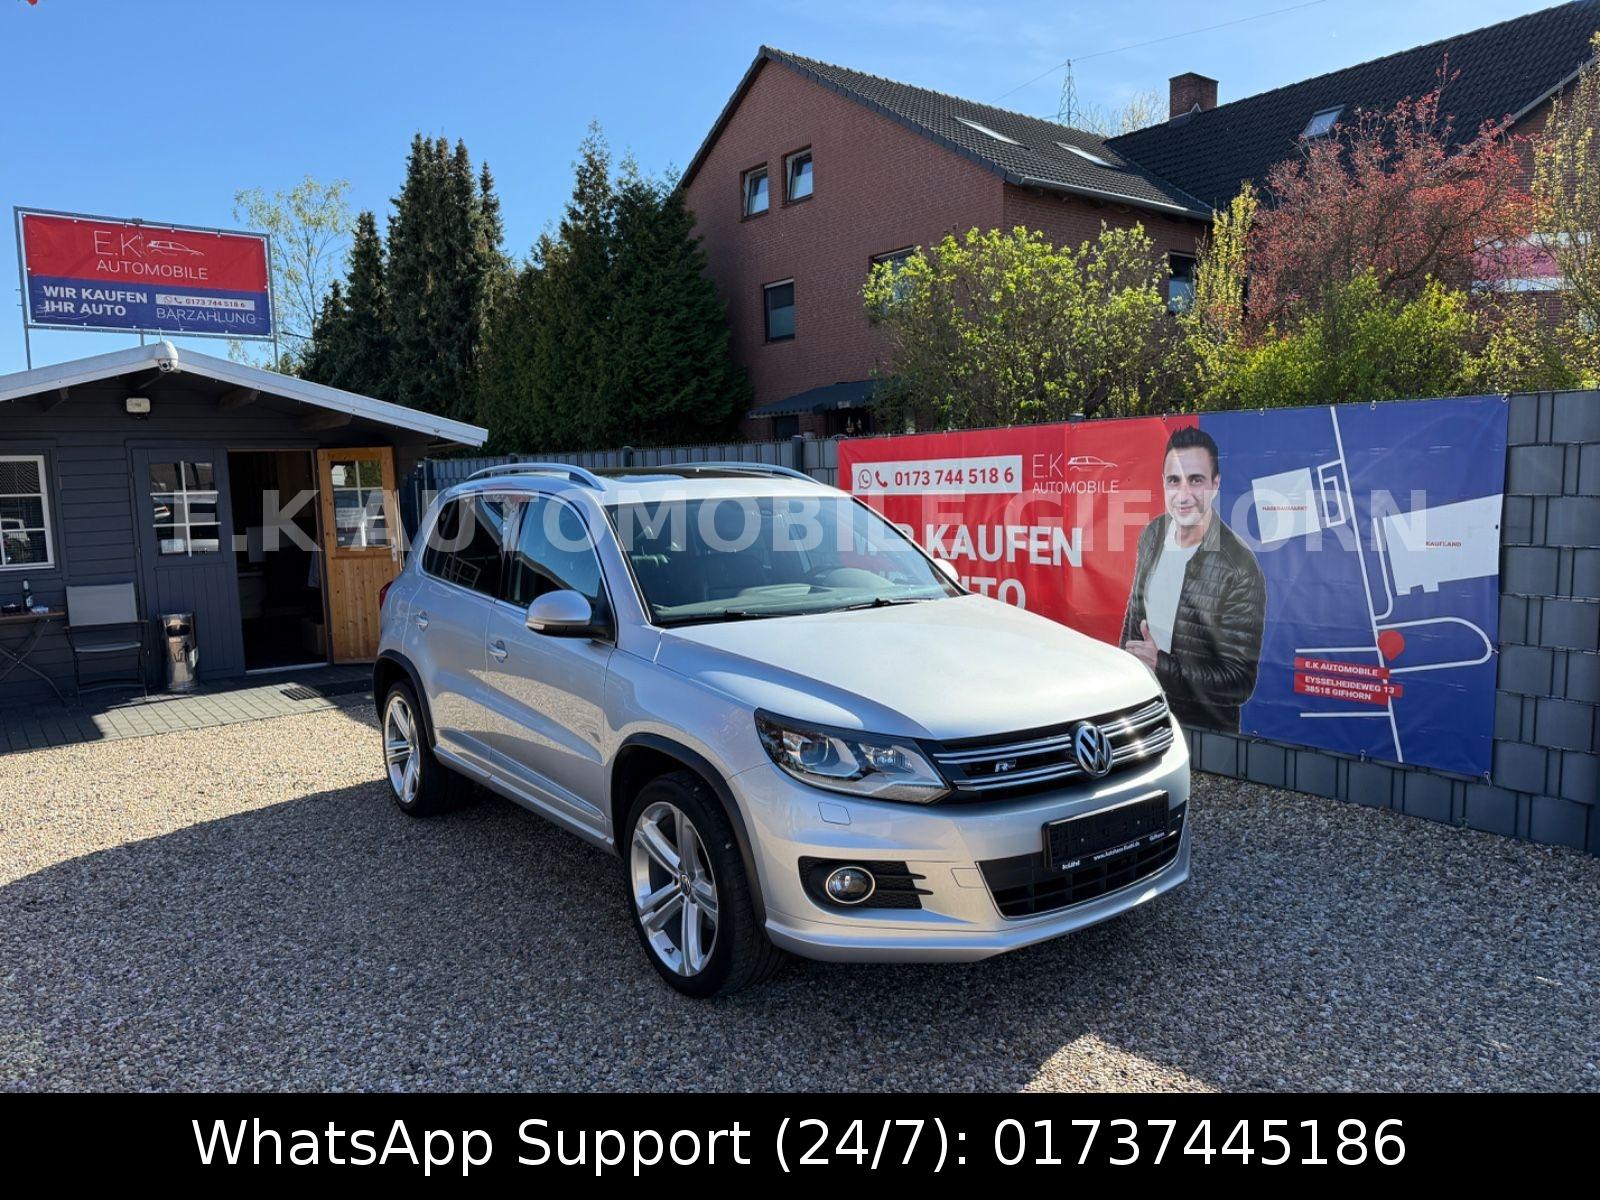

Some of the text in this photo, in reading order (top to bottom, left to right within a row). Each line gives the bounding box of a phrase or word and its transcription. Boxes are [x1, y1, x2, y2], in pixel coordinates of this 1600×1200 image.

[94, 230, 142, 257] E.K
[96, 259, 208, 280] AUTOMOBILE
[43, 285, 148, 304] WIR KAUFEN
[44, 300, 127, 316] IHR AUTO
[156, 307, 256, 325] BARZAHLUNG
[1032, 453, 1063, 478] E.K
[894, 467, 1014, 486] 0173 744 518 6
[1032, 480, 1119, 494] AUTOMOBILE
[926, 524, 1082, 568] KAUFEN
[1320, 662, 1379, 676] AUTOMOBILE
[1305, 675, 1395, 694] EYSSELHEIDEWEG 13
[1332, 689, 1371, 700] GIFHORN
